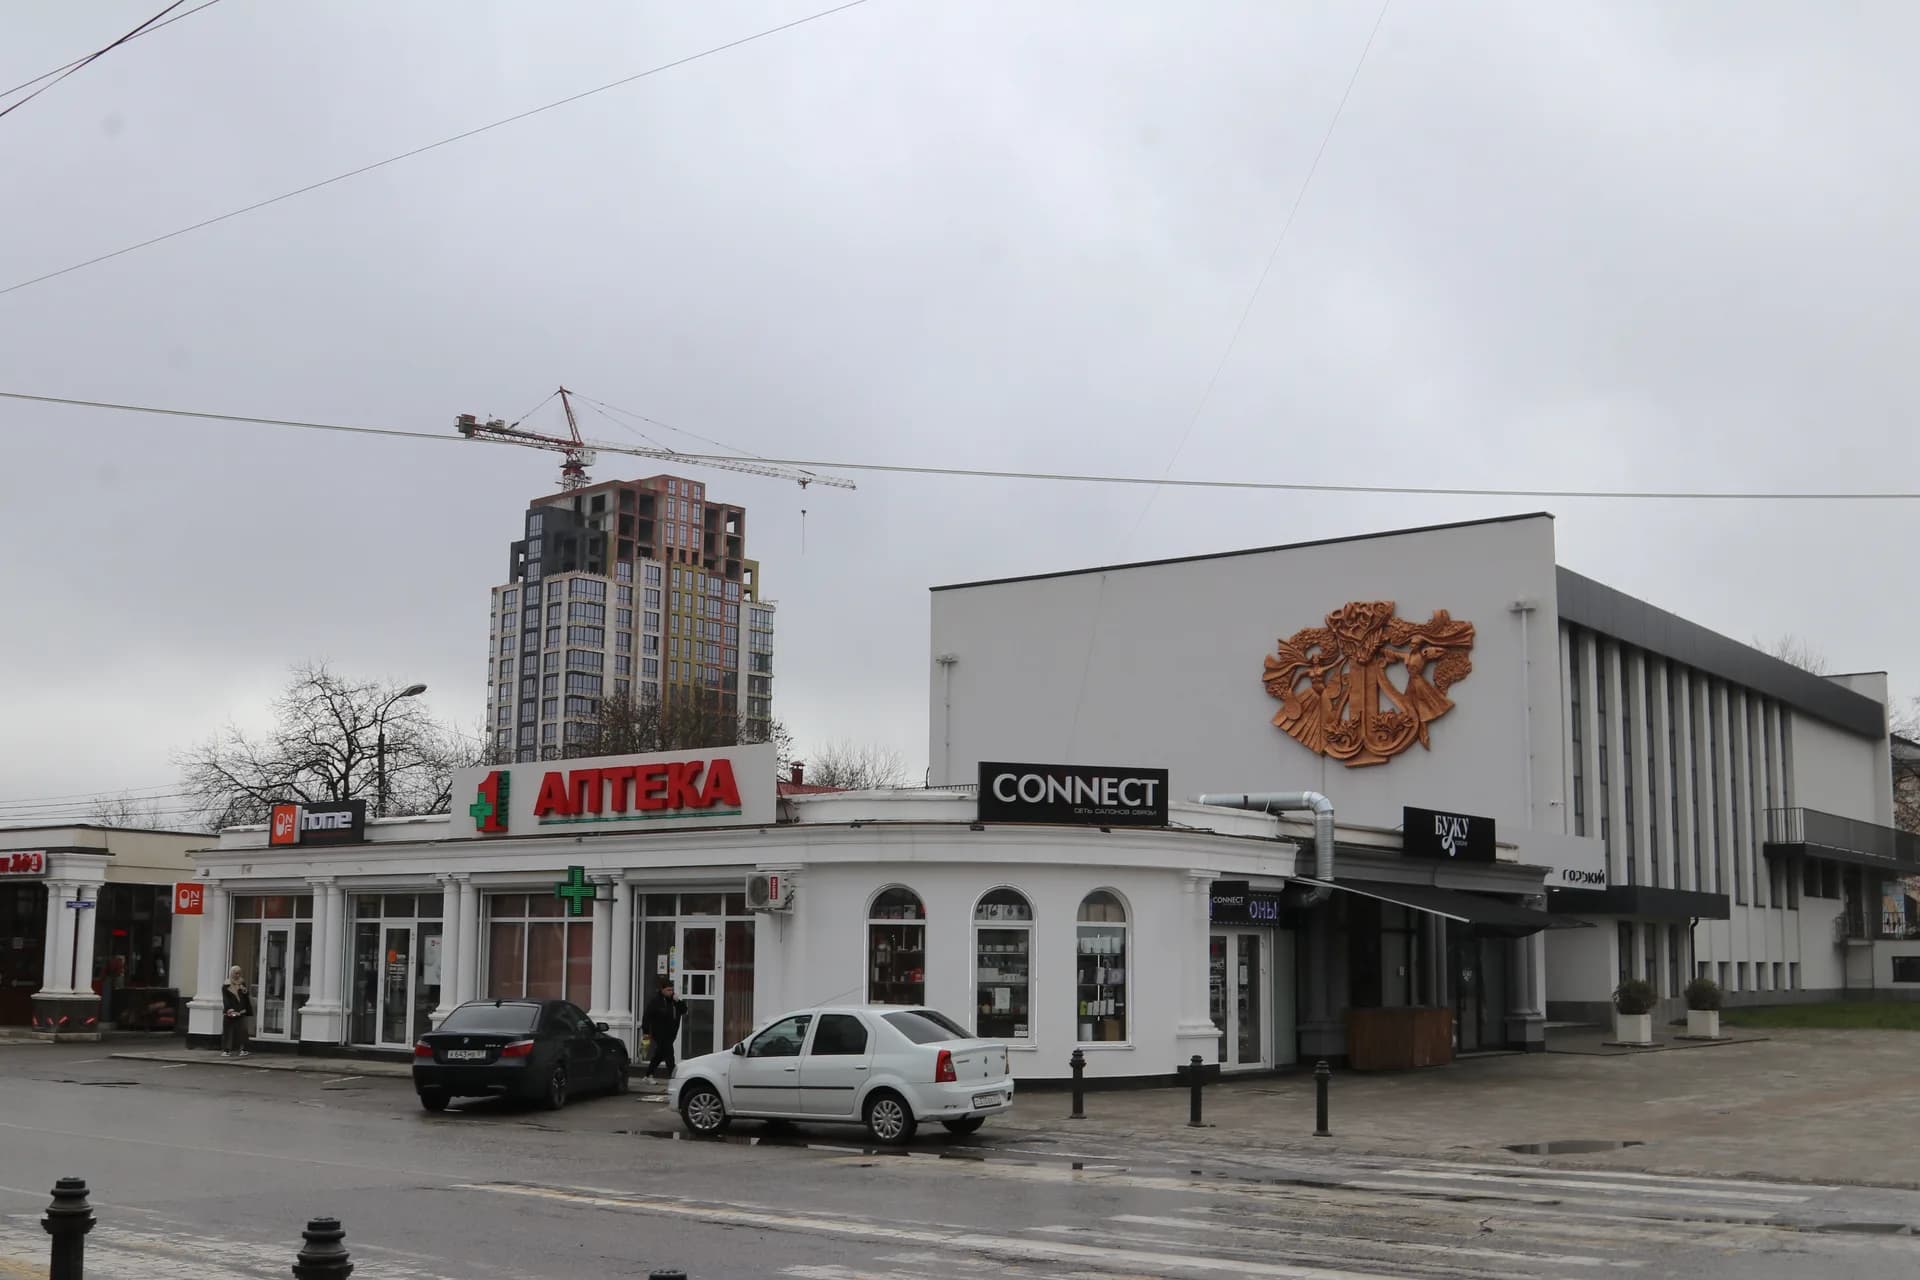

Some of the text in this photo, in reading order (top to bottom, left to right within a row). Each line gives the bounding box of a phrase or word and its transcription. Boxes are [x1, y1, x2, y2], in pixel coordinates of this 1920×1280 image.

[534, 759, 742, 816] АПТЕКА
[992, 773, 1160, 807] CONNECT
[1434, 815, 1469, 853] БУЖУ
[1212, 896, 1244, 904] CONNECT
